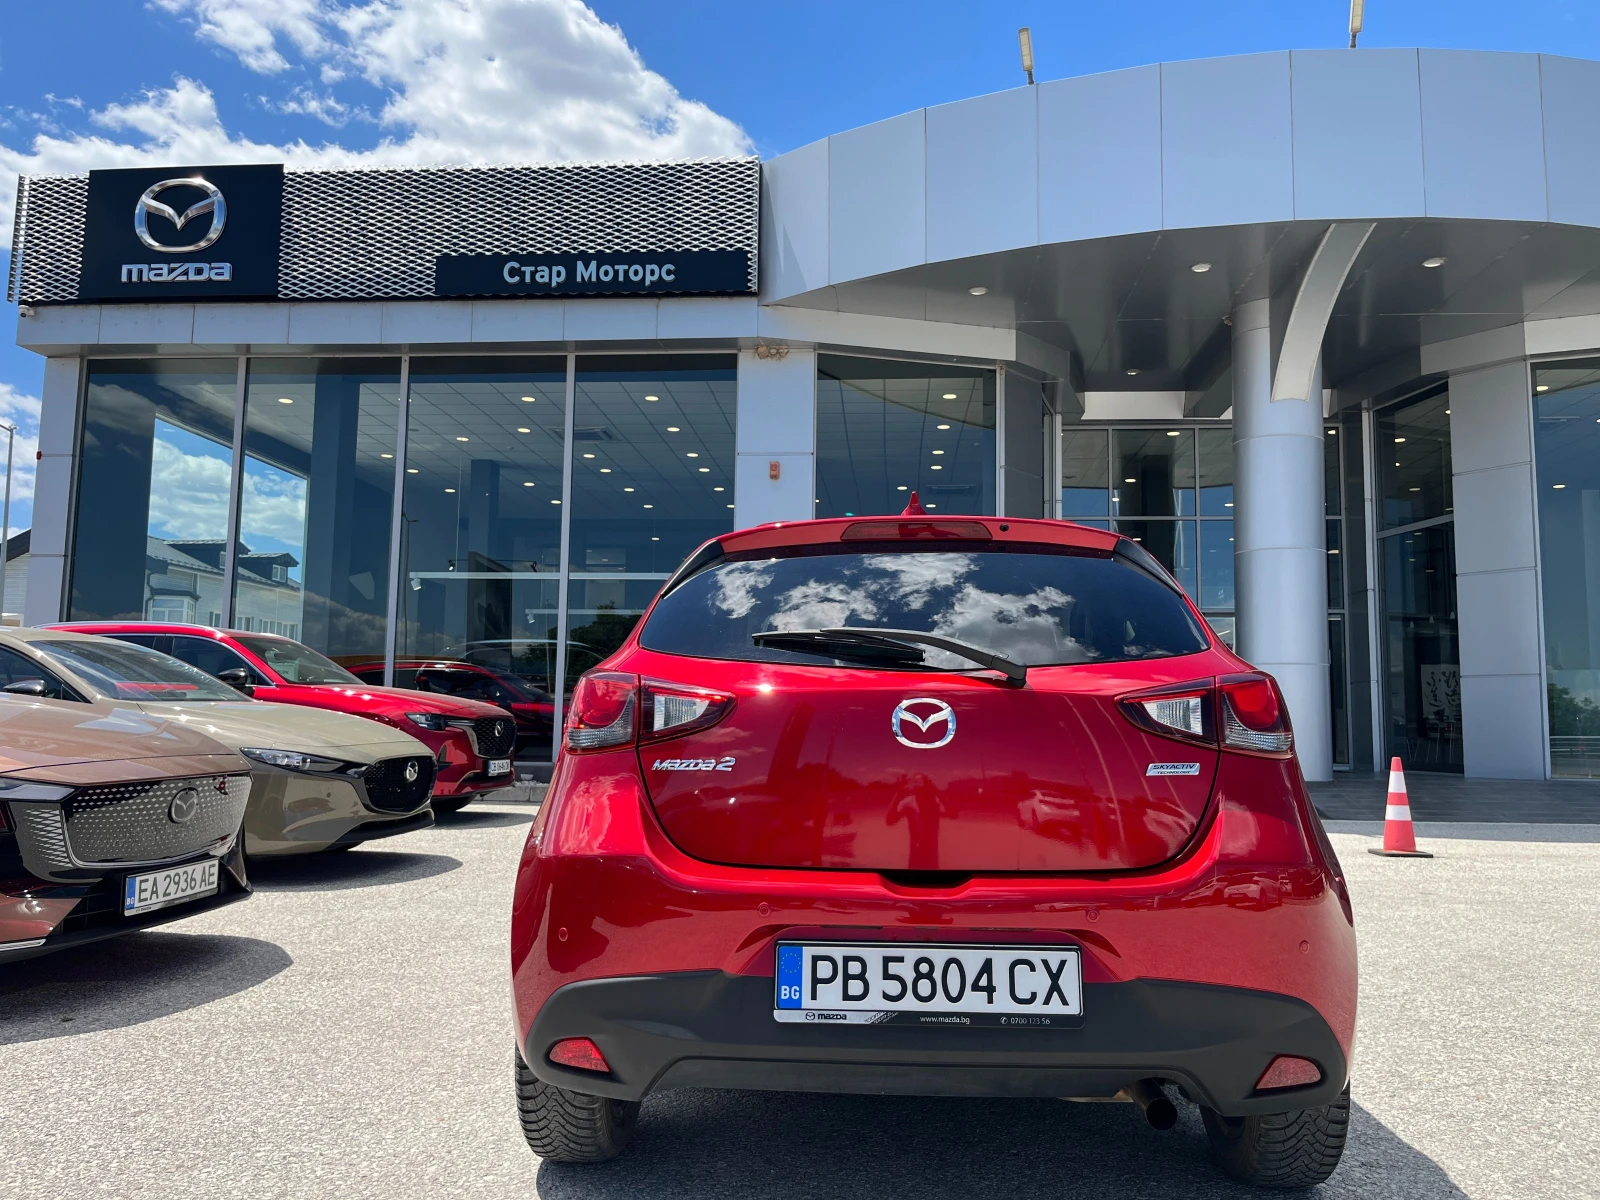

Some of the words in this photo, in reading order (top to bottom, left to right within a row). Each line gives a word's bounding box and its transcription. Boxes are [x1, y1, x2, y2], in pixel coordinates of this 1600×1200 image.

[503, 261, 567, 288] Стар
[576, 260, 676, 288] Моторс
[138, 876, 159, 903] EA
[162, 868, 197, 898] 2936
[199, 863, 216, 889] AE
[126, 897, 135, 906] BG
[810, 954, 870, 1002] PB
[881, 956, 996, 1005] 5804
[1008, 958, 1070, 1007] CX
[780, 985, 800, 1000] BG
[919, 1015, 970, 1025] www.mazda.bg
[1010, 1017, 1027, 1025] 0700
